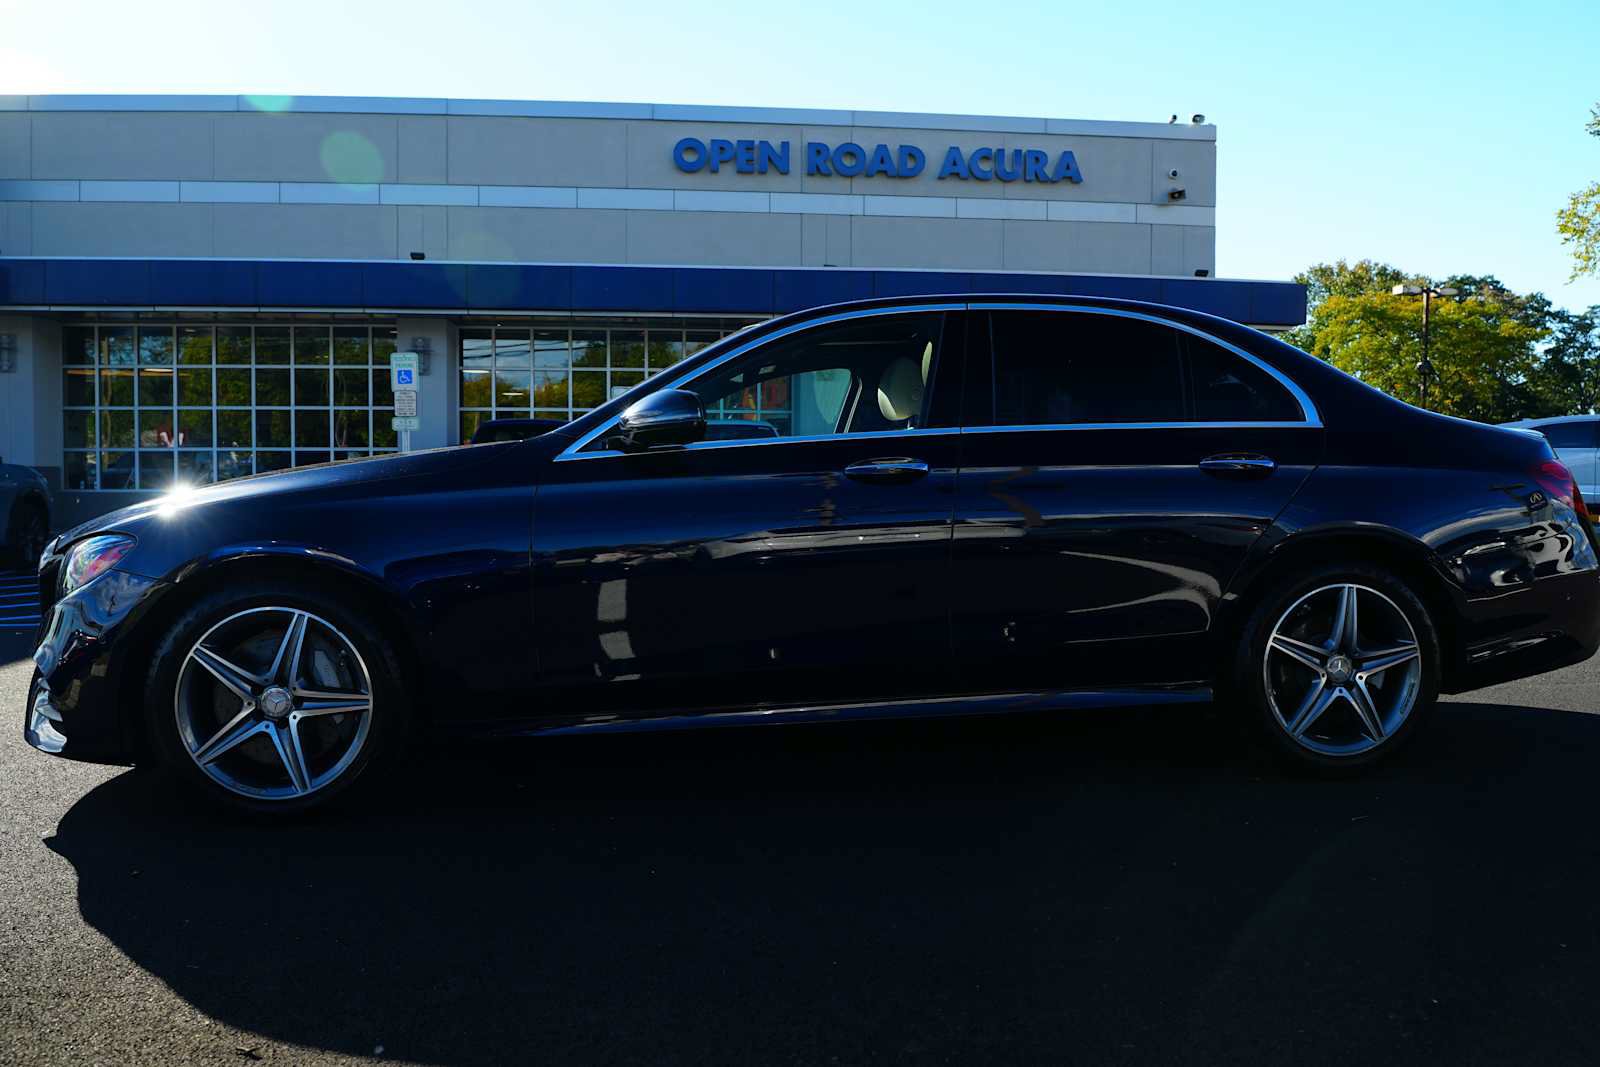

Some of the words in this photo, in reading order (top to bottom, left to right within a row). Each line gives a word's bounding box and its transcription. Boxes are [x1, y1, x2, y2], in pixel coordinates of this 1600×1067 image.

[673, 137, 790, 175] OPEN
[807, 142, 926, 178] ROAD
[938, 146, 1083, 184] ACURA
